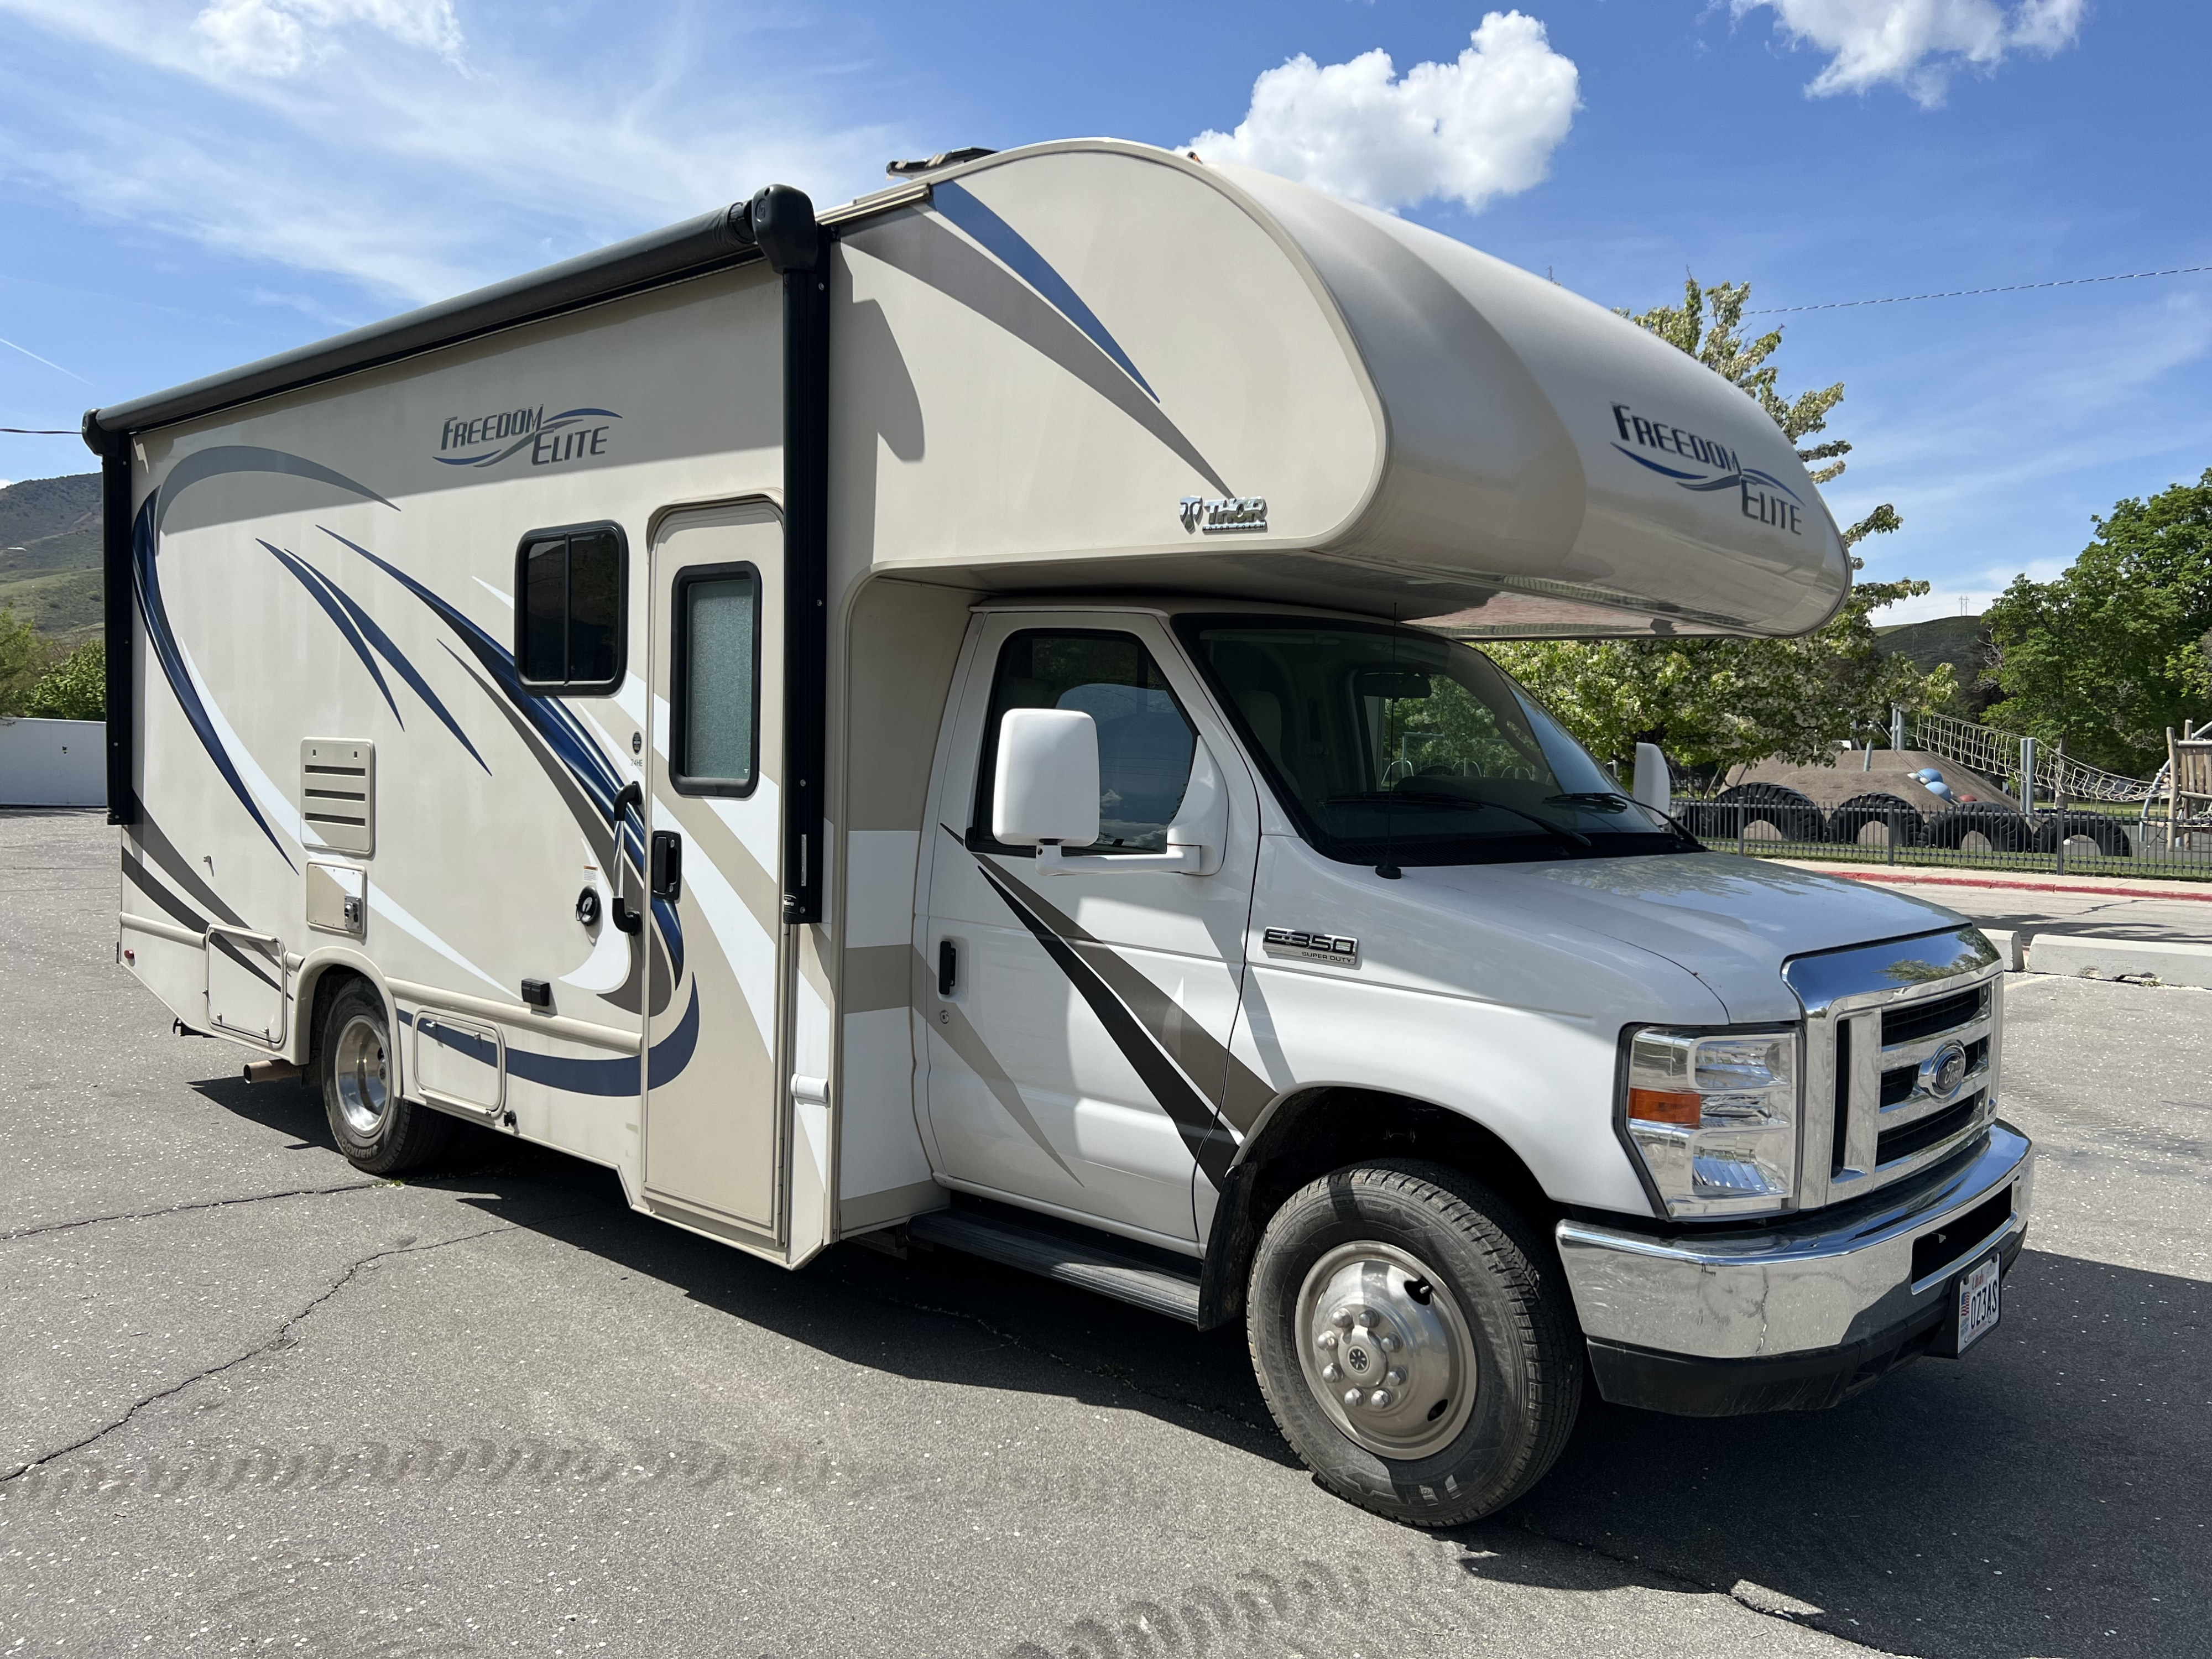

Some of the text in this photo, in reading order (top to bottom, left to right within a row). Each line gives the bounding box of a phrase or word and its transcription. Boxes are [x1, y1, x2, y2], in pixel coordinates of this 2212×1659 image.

[441, 404, 544, 451] FREEDOM
[531, 426, 609, 466] ELITE
[1610, 401, 1743, 476] FREEDOM
[1203, 496, 1266, 524] THOR
[1740, 476, 1802, 536] ELITE
[1301, 951, 1328, 959] SUPER
[1944, 1056, 1963, 1084] Ford
